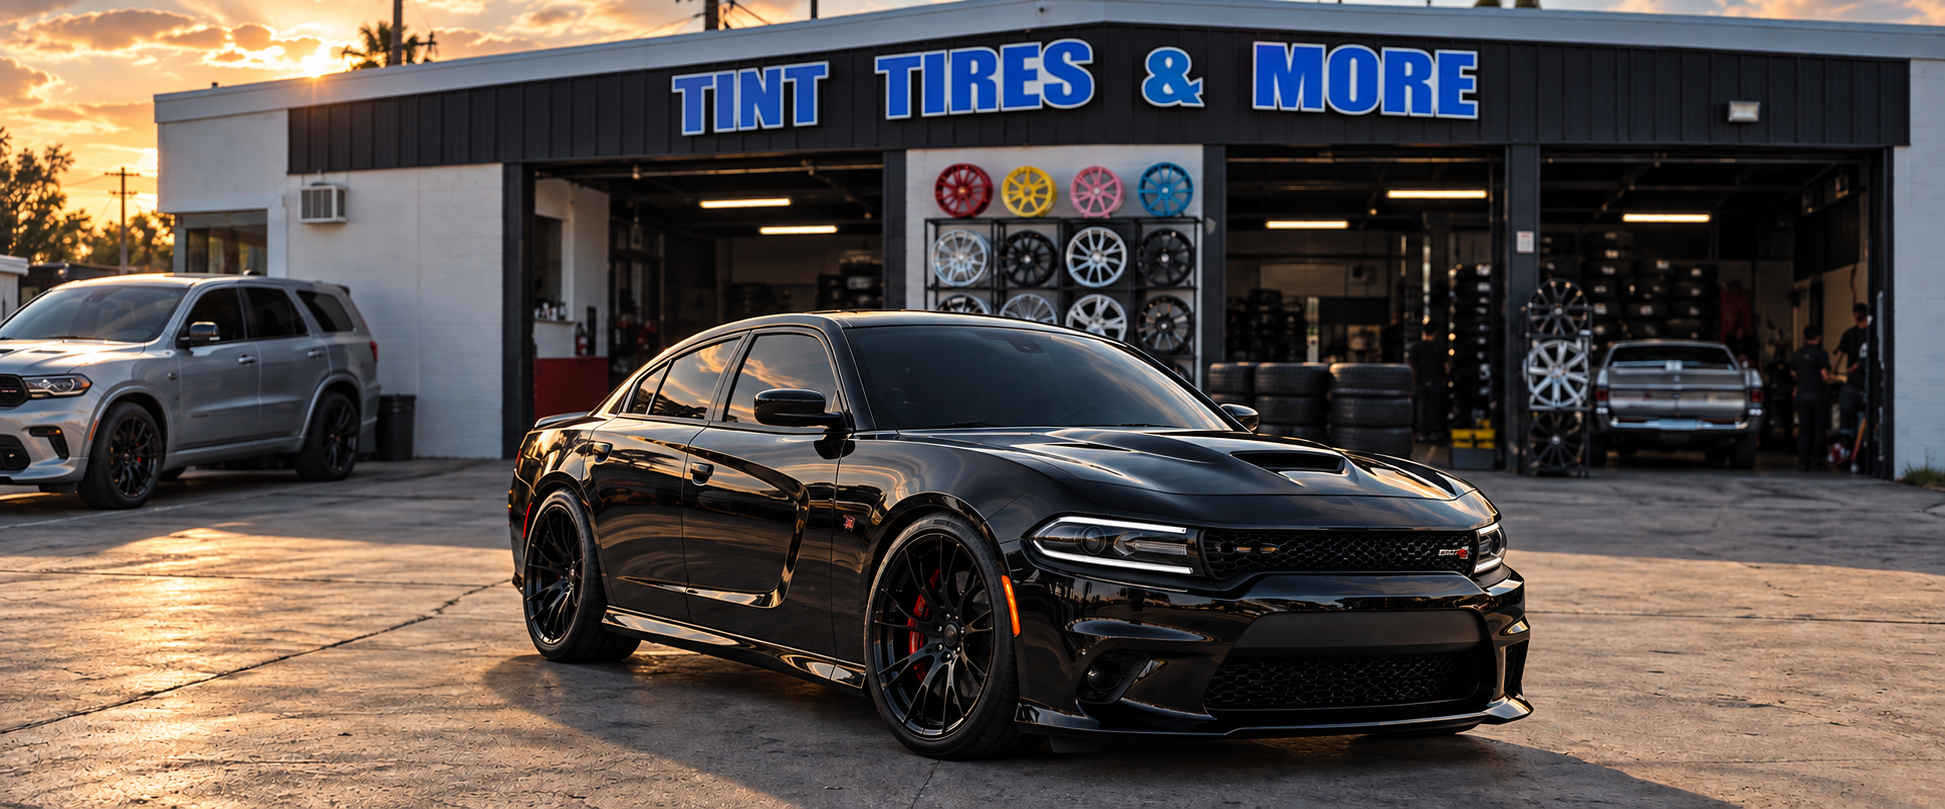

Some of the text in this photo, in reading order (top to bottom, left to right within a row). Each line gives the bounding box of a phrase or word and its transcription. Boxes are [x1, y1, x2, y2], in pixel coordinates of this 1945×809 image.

[672, 39, 1478, 136] TINT TIRES & MORE
